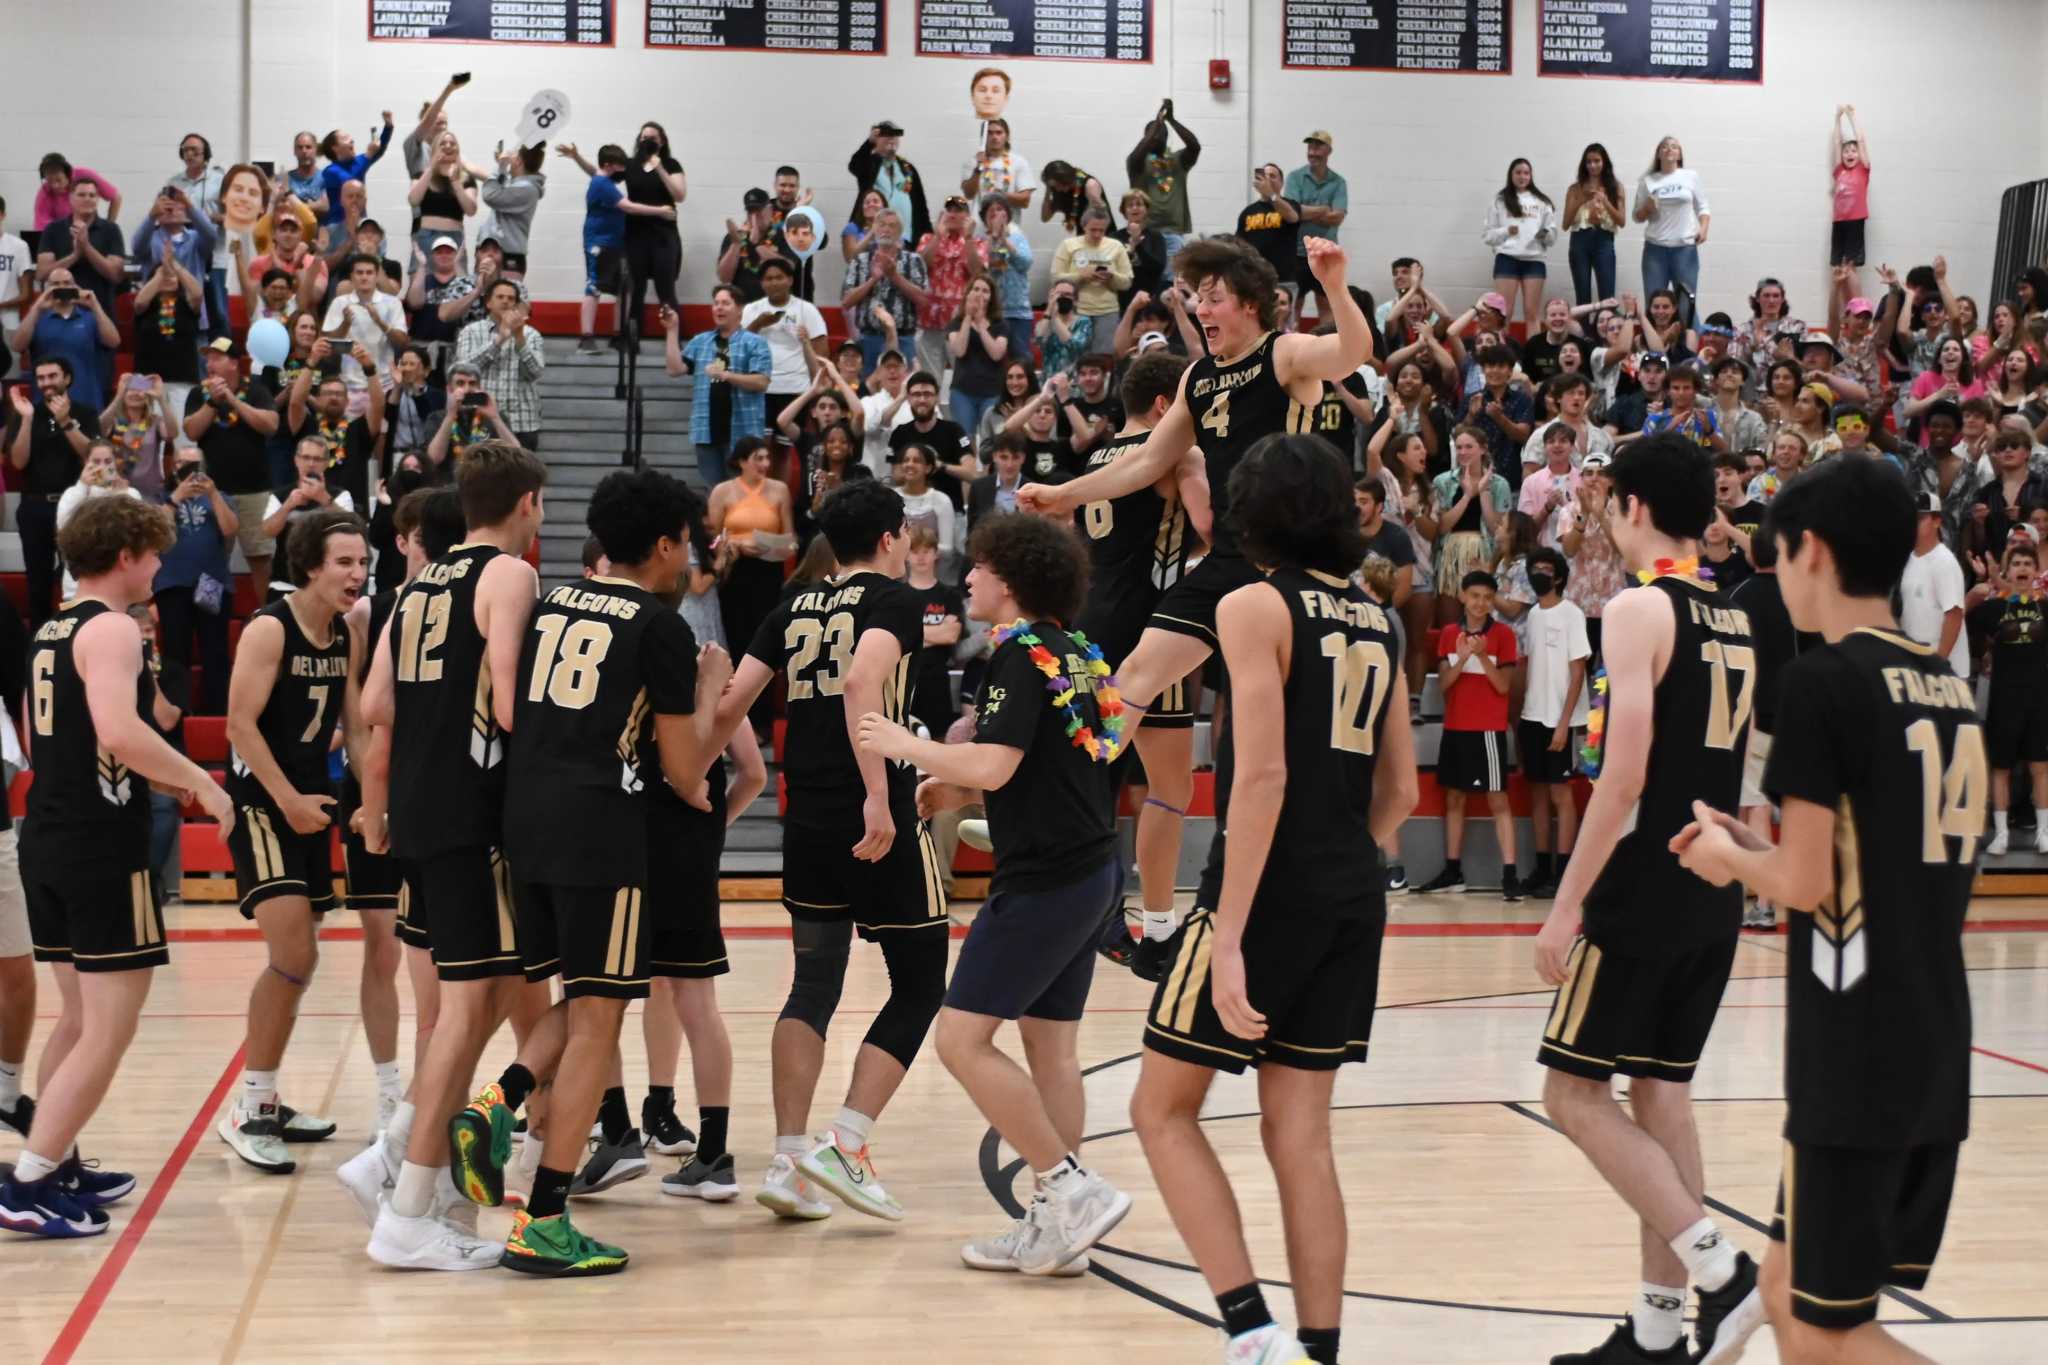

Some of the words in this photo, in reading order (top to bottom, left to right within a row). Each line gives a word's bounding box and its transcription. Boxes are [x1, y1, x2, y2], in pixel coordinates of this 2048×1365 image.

[1200, 390, 1232, 438] 4
[397, 588, 453, 683] 12
[543, 585, 641, 620] FALCONS
[32, 648, 56, 737] 6
[527, 612, 614, 710] 18
[784, 611, 856, 703] 23
[1319, 630, 1390, 757] 10
[1700, 638, 1757, 751] 17
[299, 685, 329, 743] 7
[1904, 718, 1990, 865] 14
